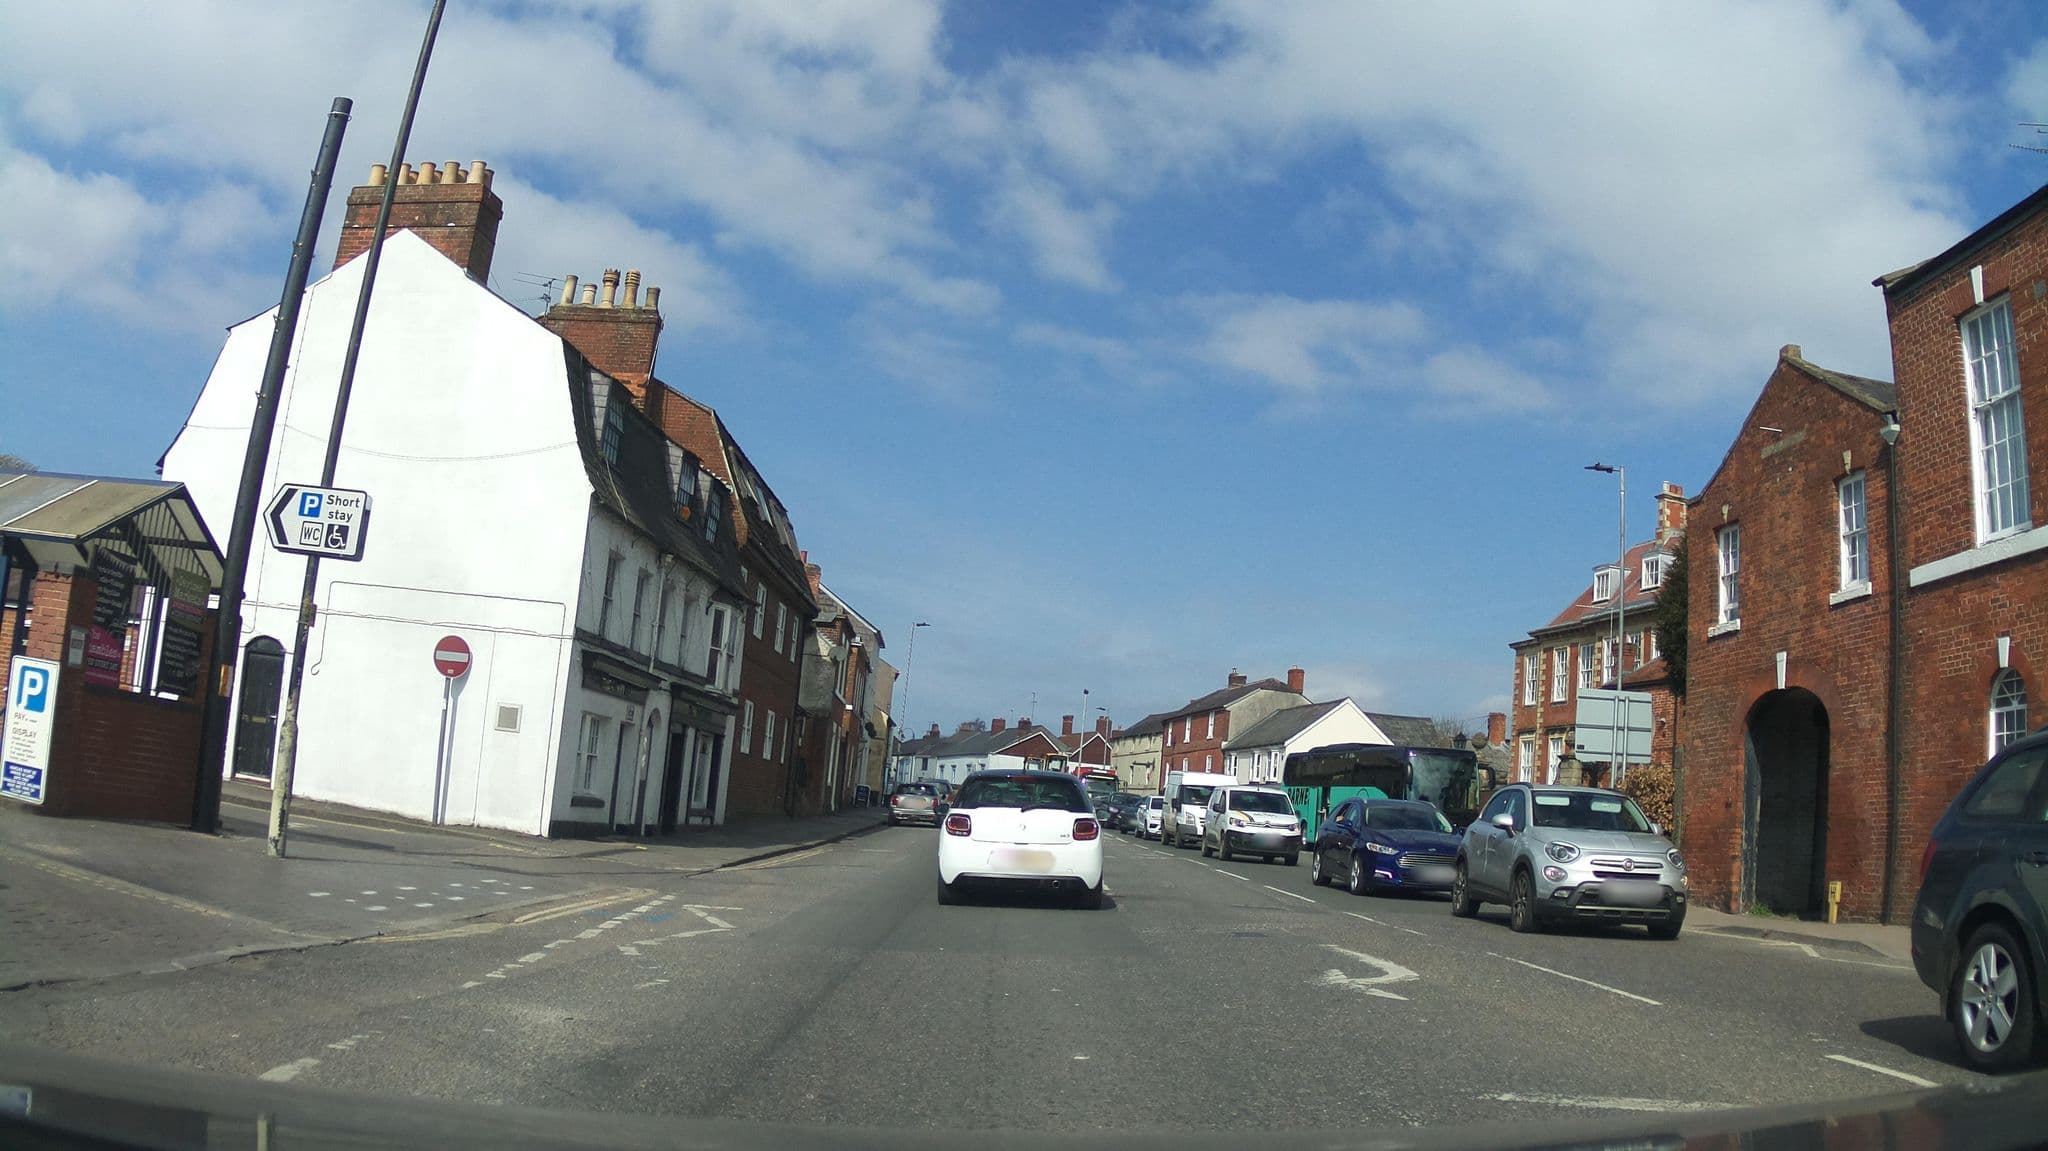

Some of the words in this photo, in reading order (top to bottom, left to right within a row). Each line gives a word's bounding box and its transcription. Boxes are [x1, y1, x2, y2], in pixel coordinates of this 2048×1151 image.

[303, 495, 319, 515] P
[326, 494, 360, 508] Short
[328, 509, 353, 523] stay
[303, 526, 320, 541] WC
[19, 669, 43, 708] P
[14, 712, 26, 720] PAY
[12, 727, 37, 738] DISPLAY
